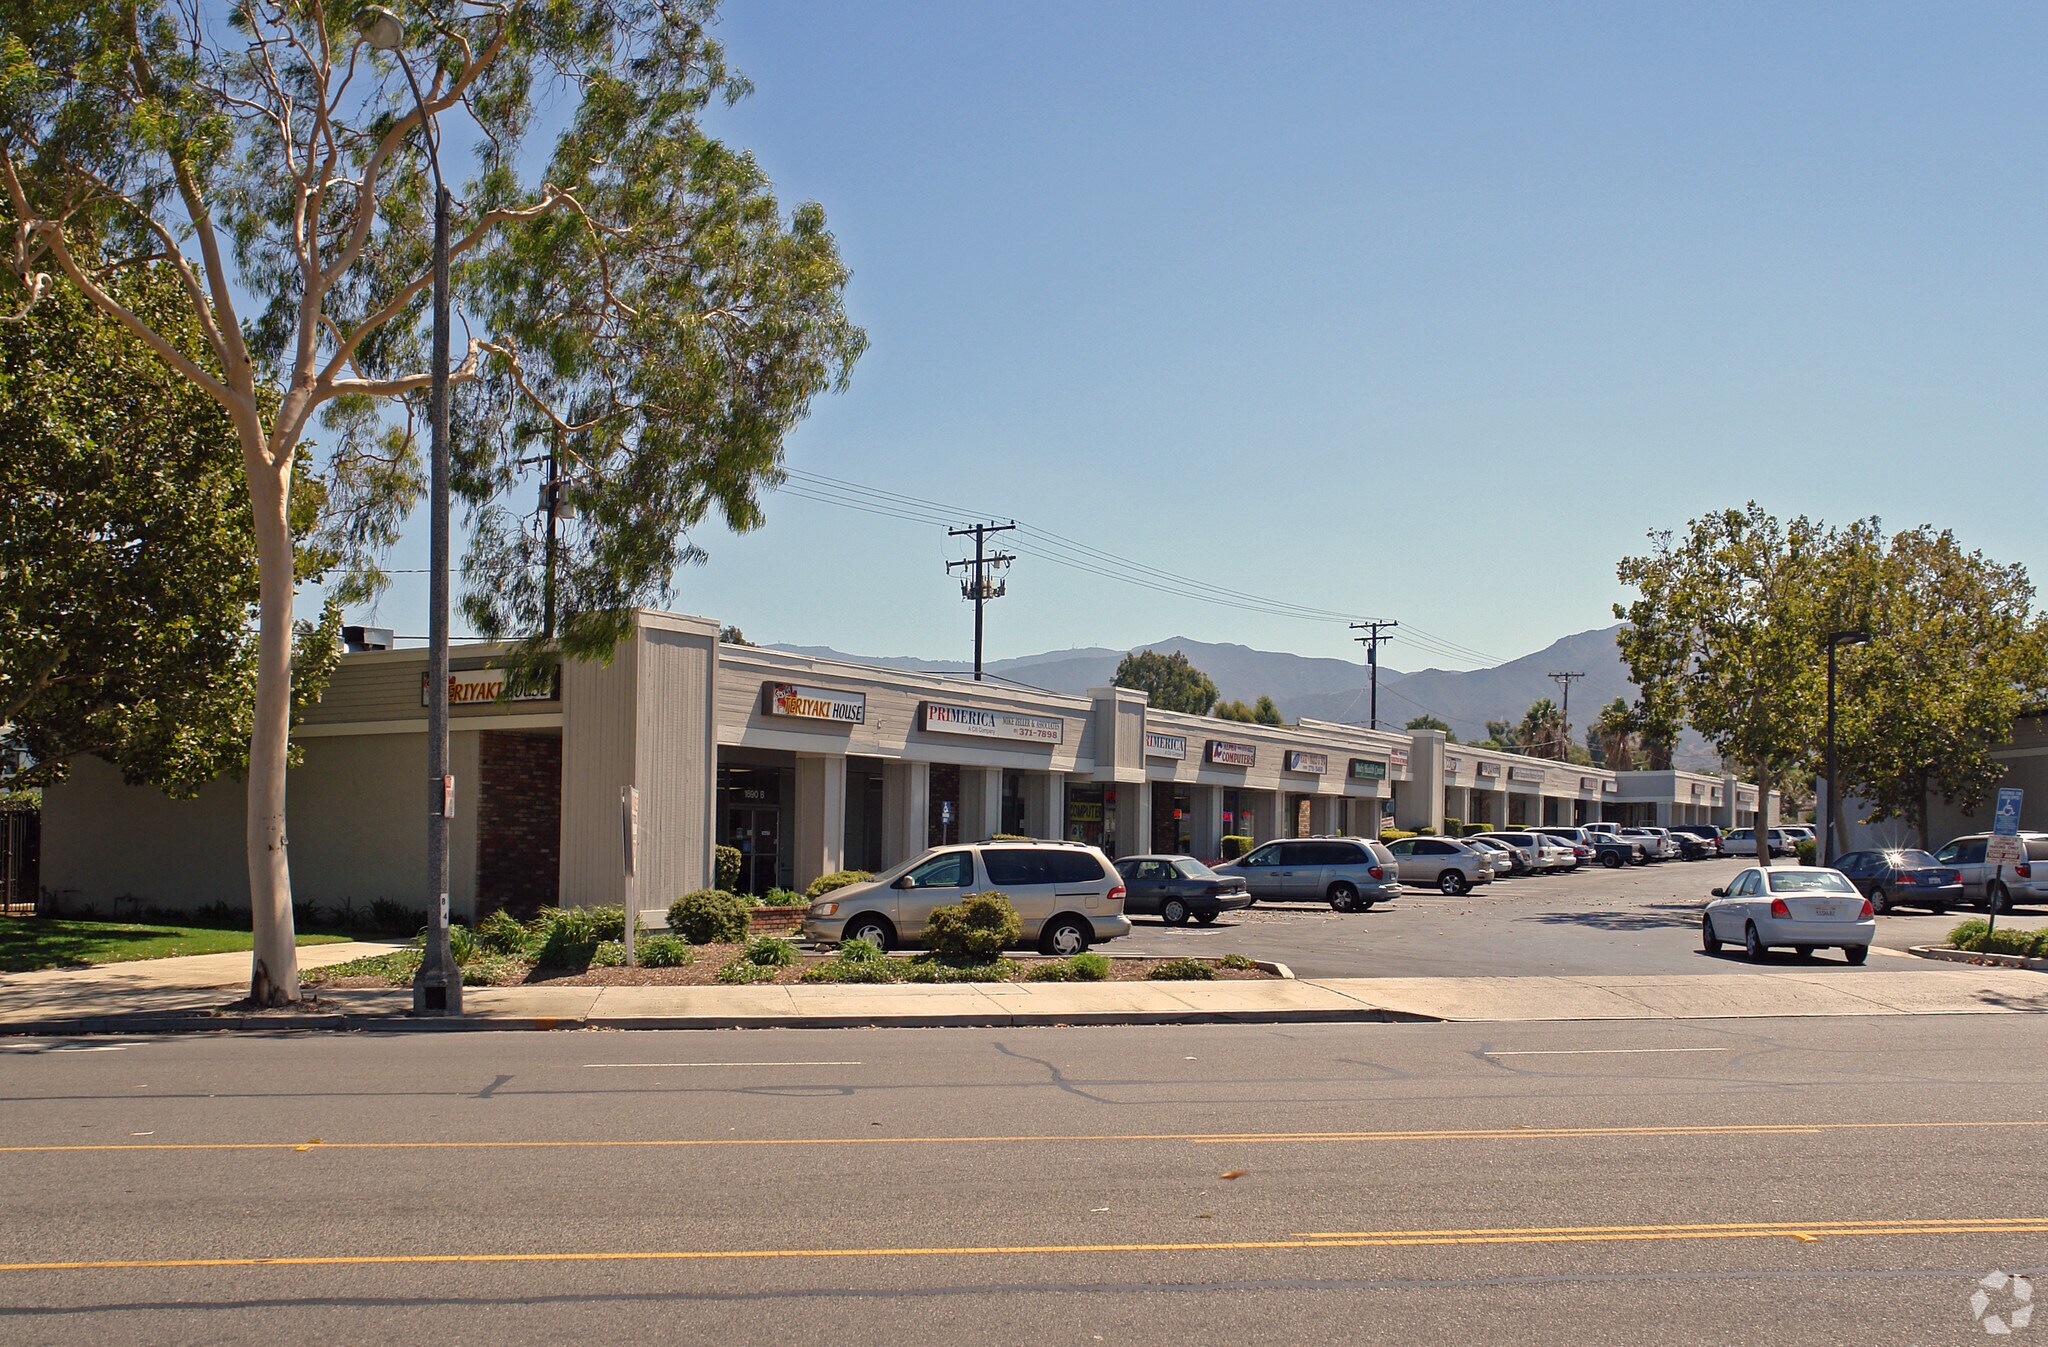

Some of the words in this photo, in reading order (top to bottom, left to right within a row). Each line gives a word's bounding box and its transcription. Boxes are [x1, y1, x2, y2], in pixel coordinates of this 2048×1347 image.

[448, 681, 503, 703] ERIYAKI
[785, 696, 832, 717] TERIYAKI
[832, 703, 863, 720] HOUSE
[929, 705, 996, 728] PRIMERICA
[1019, 727, 1058, 739] 371-7898
[1146, 734, 1184, 752] RIMERICA
[1222, 751, 1254, 766] COMPUTERS
[441, 897, 446, 905] 8
